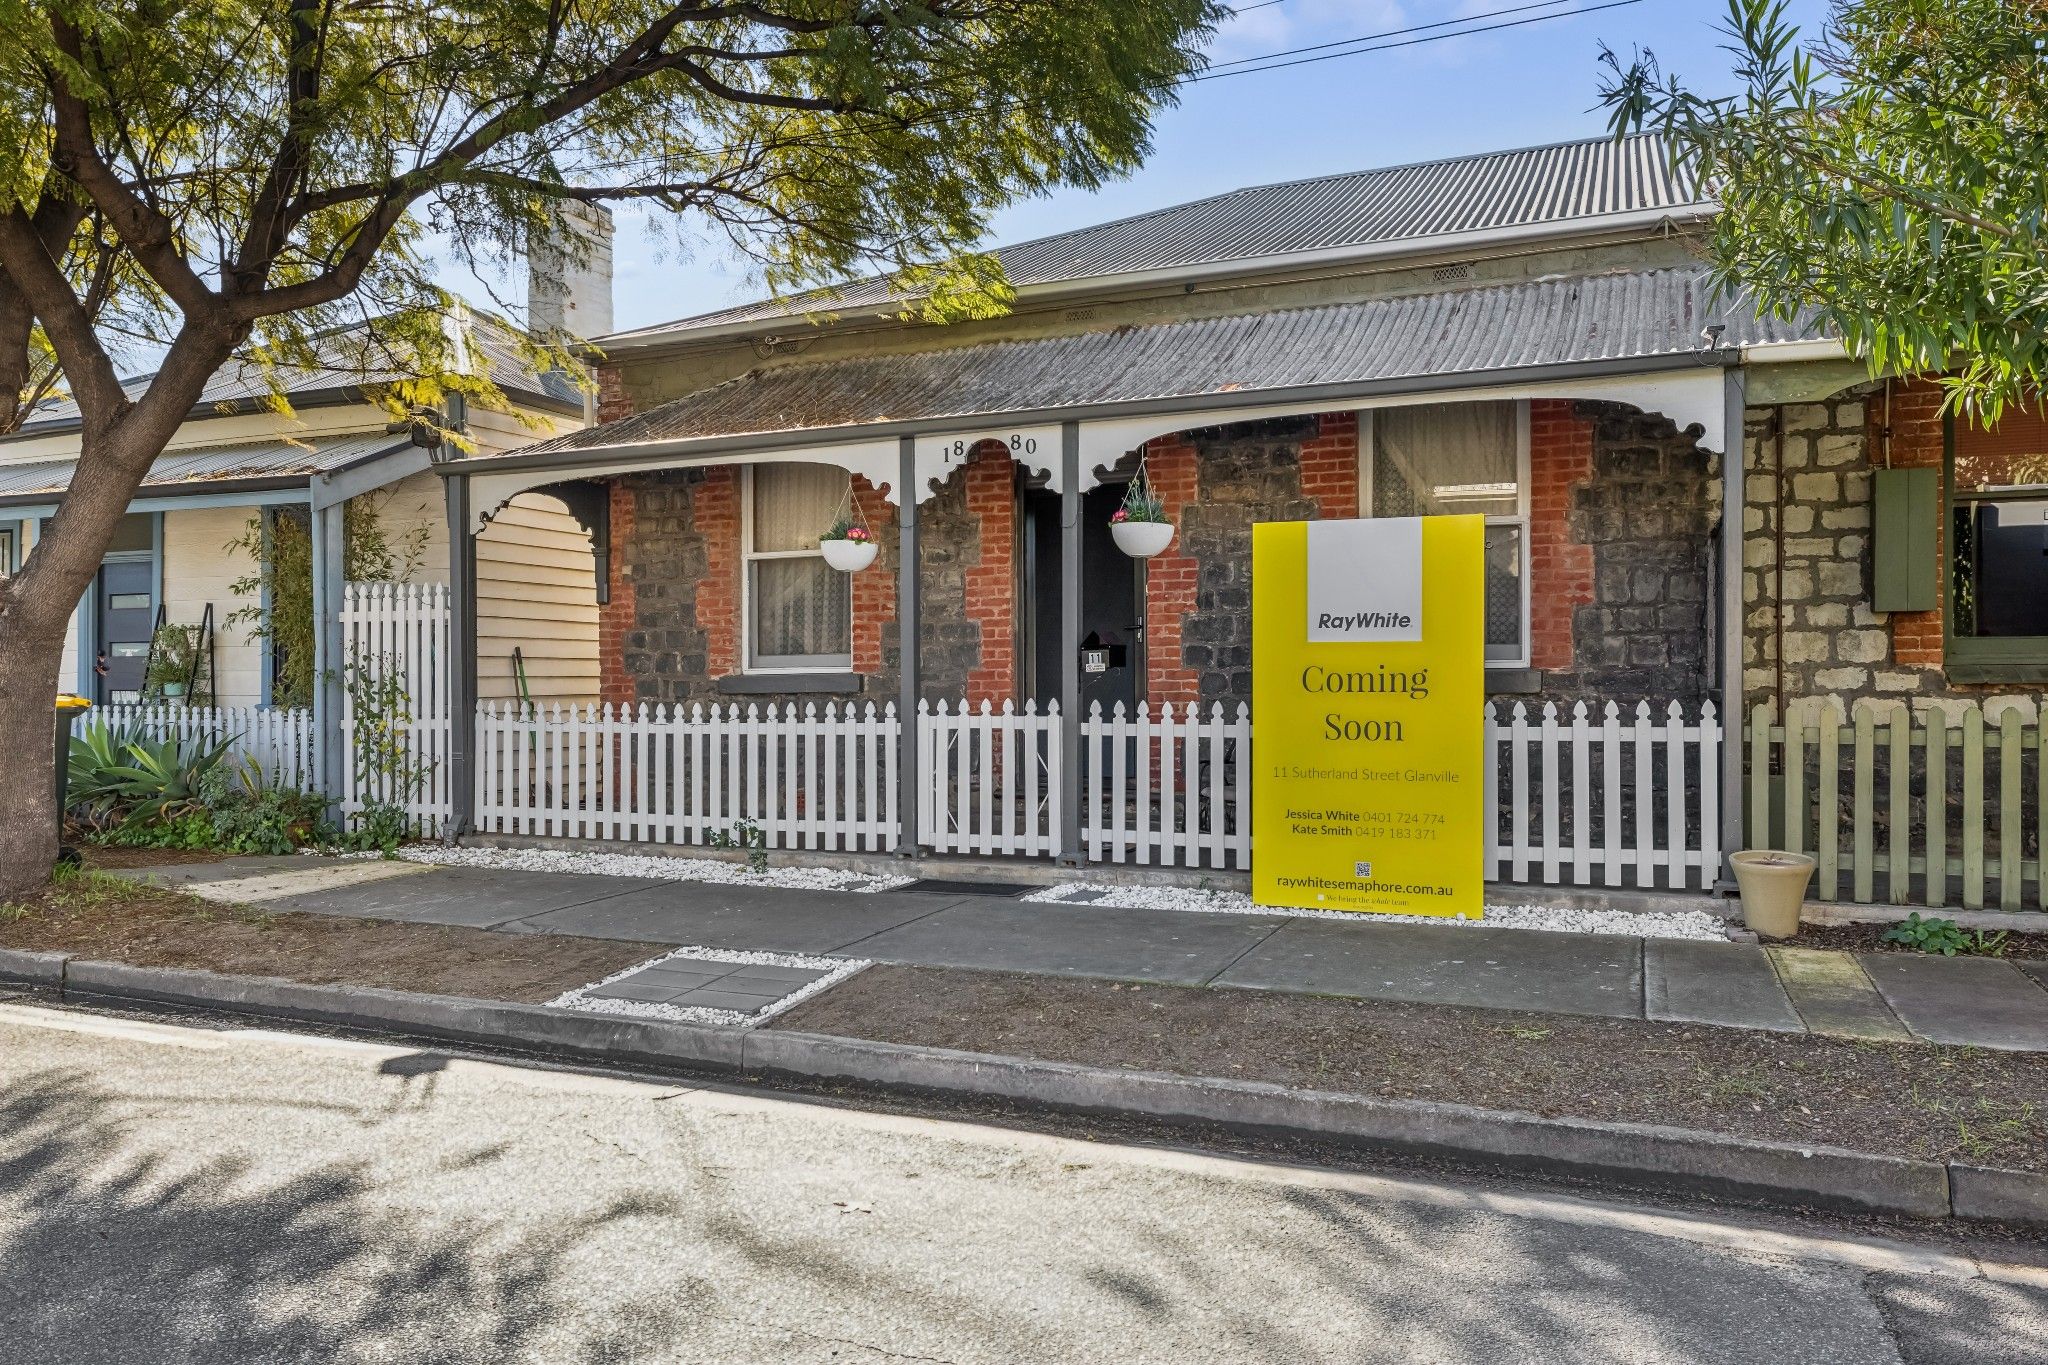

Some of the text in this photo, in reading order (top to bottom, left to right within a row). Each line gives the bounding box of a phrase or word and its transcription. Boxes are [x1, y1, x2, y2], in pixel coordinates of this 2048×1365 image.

[1090, 653, 1100, 664] 11
[1302, 664, 1429, 700] Coming
[1325, 713, 1404, 742] Soon
[1273, 766, 1460, 783] 11 Sutherland Street Glanville
[1285, 809, 1445, 825] Jessica White 0401 724 774
[1292, 823, 1318, 835] Kate
[1321, 825, 1353, 837] Smith
[1355, 826, 1385, 838] 0419
[1415, 828, 1436, 840] 371
[1277, 876, 1453, 897] raywhitesemaphore.com.au
